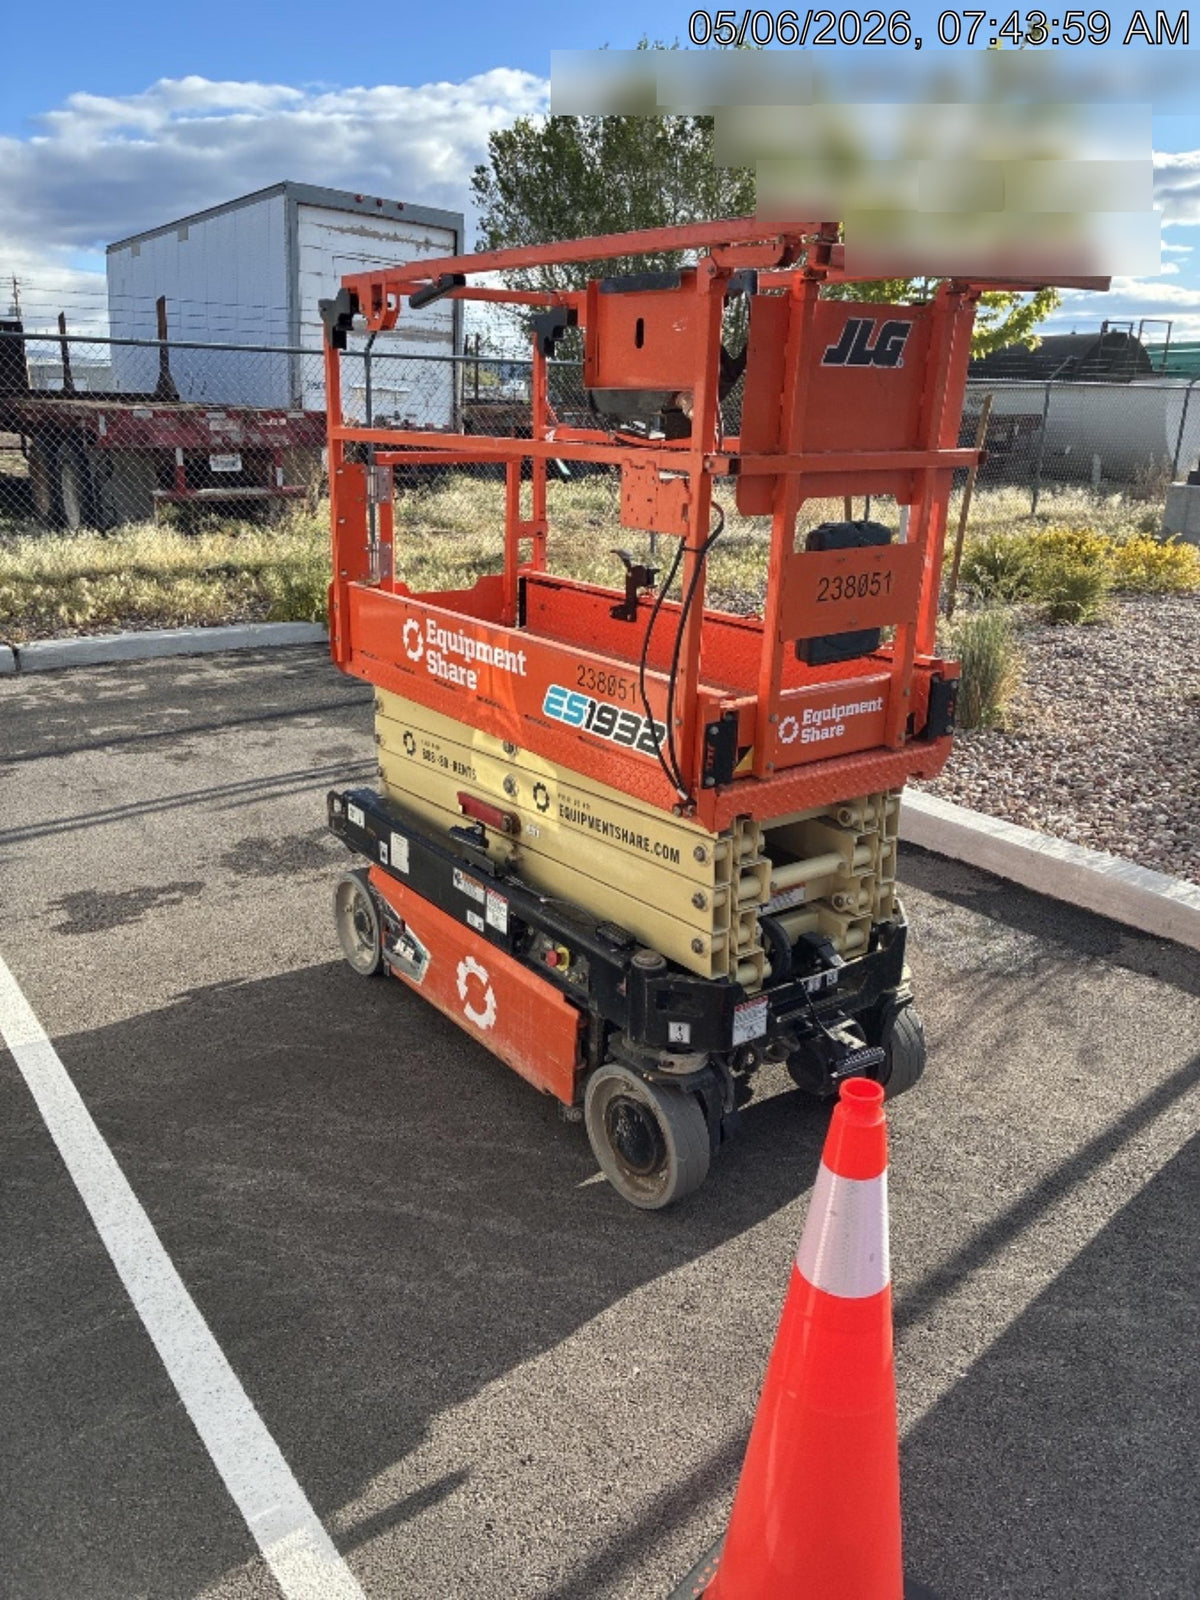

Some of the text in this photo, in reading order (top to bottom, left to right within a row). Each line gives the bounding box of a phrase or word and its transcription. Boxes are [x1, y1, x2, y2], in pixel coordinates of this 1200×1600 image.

[821, 316, 913, 368] JLG
[816, 570, 892, 602] 238051
[426, 618, 527, 677] Equipment
[426, 649, 477, 690] Share
[577, 664, 636, 704] 238051
[542, 683, 668, 760] ES1932
[802, 696, 884, 726] Equipment
[801, 724, 845, 744] Share
[559, 803, 680, 864] EQUIPMENTSHARE.COM
